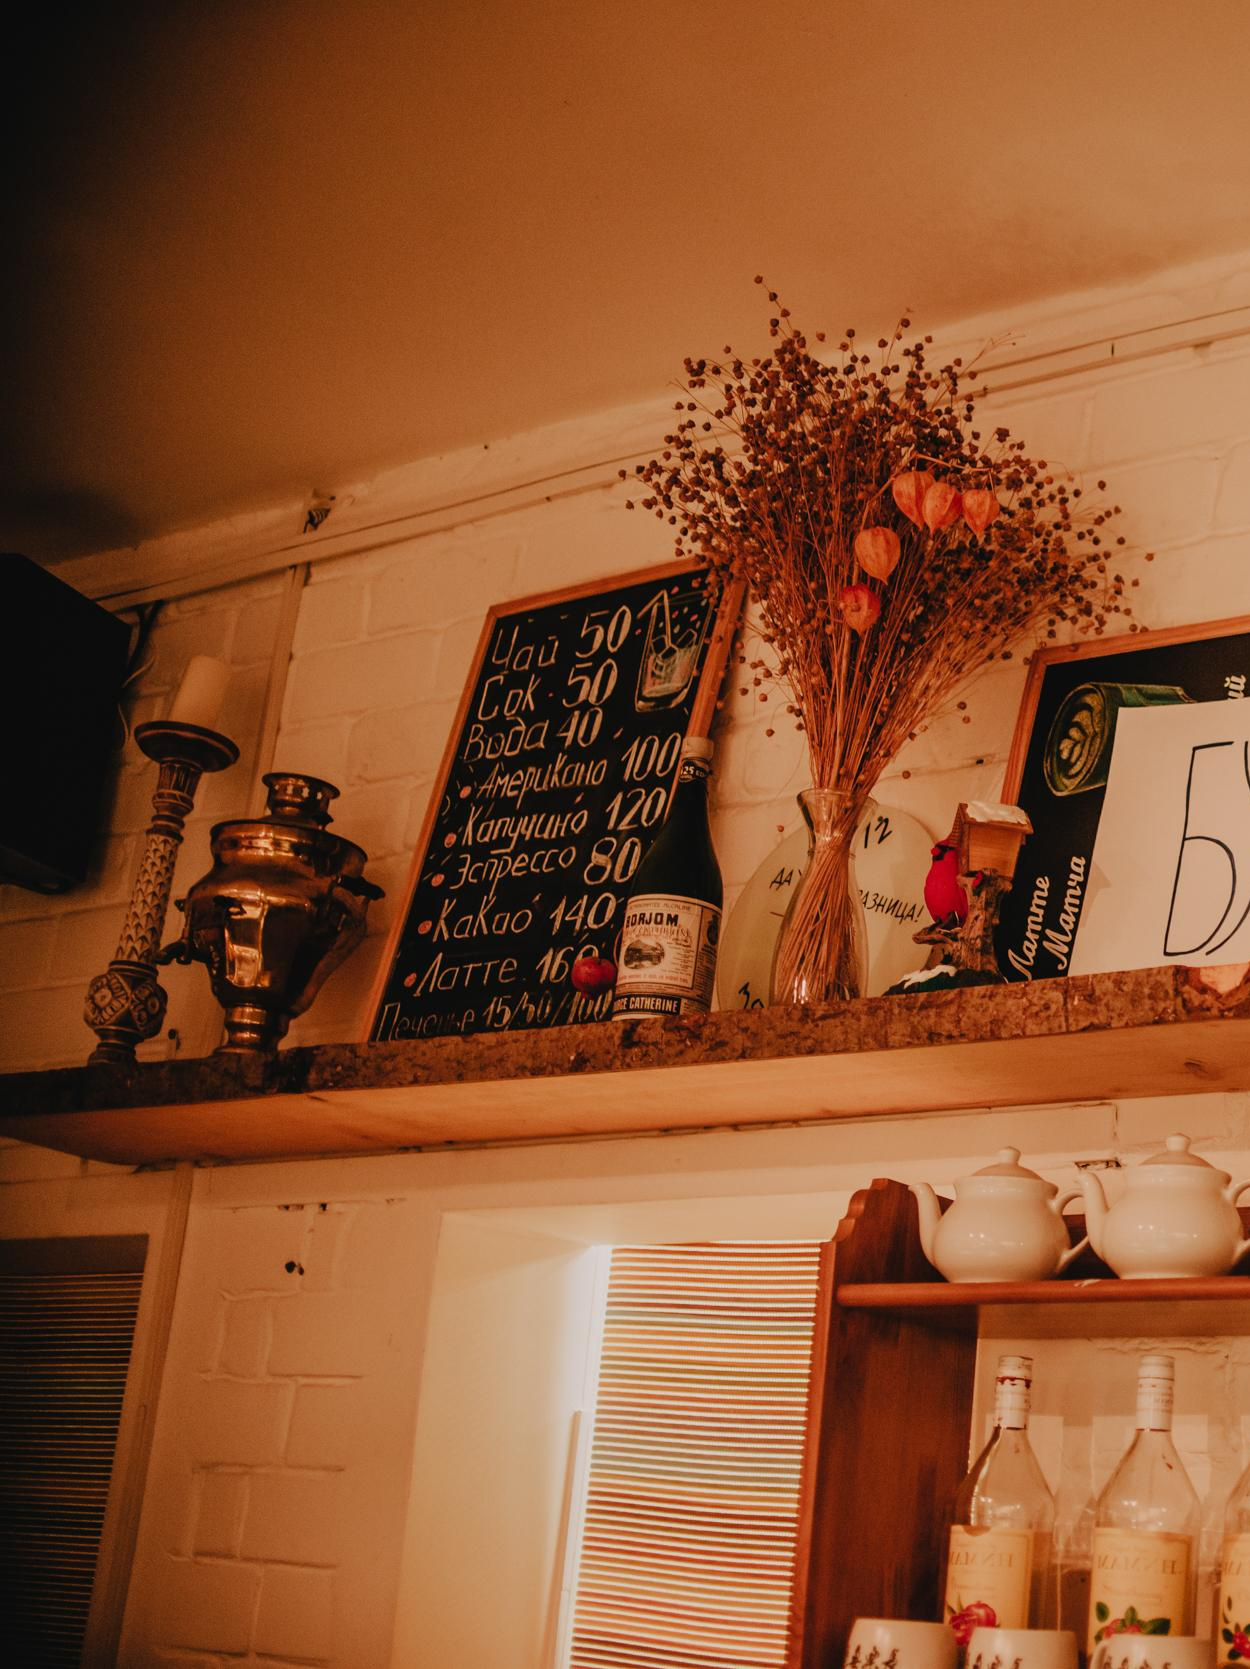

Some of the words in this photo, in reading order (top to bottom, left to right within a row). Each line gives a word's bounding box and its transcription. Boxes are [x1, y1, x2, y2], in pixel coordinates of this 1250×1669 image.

[491, 624, 560, 675] Чай
[576, 605, 632, 659] 50
[477, 672, 542, 721] Сок
[562, 658, 619, 708] 50
[462, 716, 550, 763] Вода
[556, 707, 604, 749] 40
[476, 751, 608, 811] Американо
[620, 731, 683, 783] 100
[461, 802, 589, 855] Капучино
[605, 786, 668, 831] 120
[863, 815, 893, 850] 12
[449, 845, 577, 900] Эспрессо
[583, 836, 643, 886] 80
[432, 895, 534, 943] Какао
[549, 892, 617, 937] 140
[859, 889, 925, 926] АЗНИЦА!
[1007, 875, 1050, 981] Латте
[1042, 856, 1086, 971] Матча
[412, 952, 518, 998] Латте
[629, 996, 679, 1013] CATHERINE
